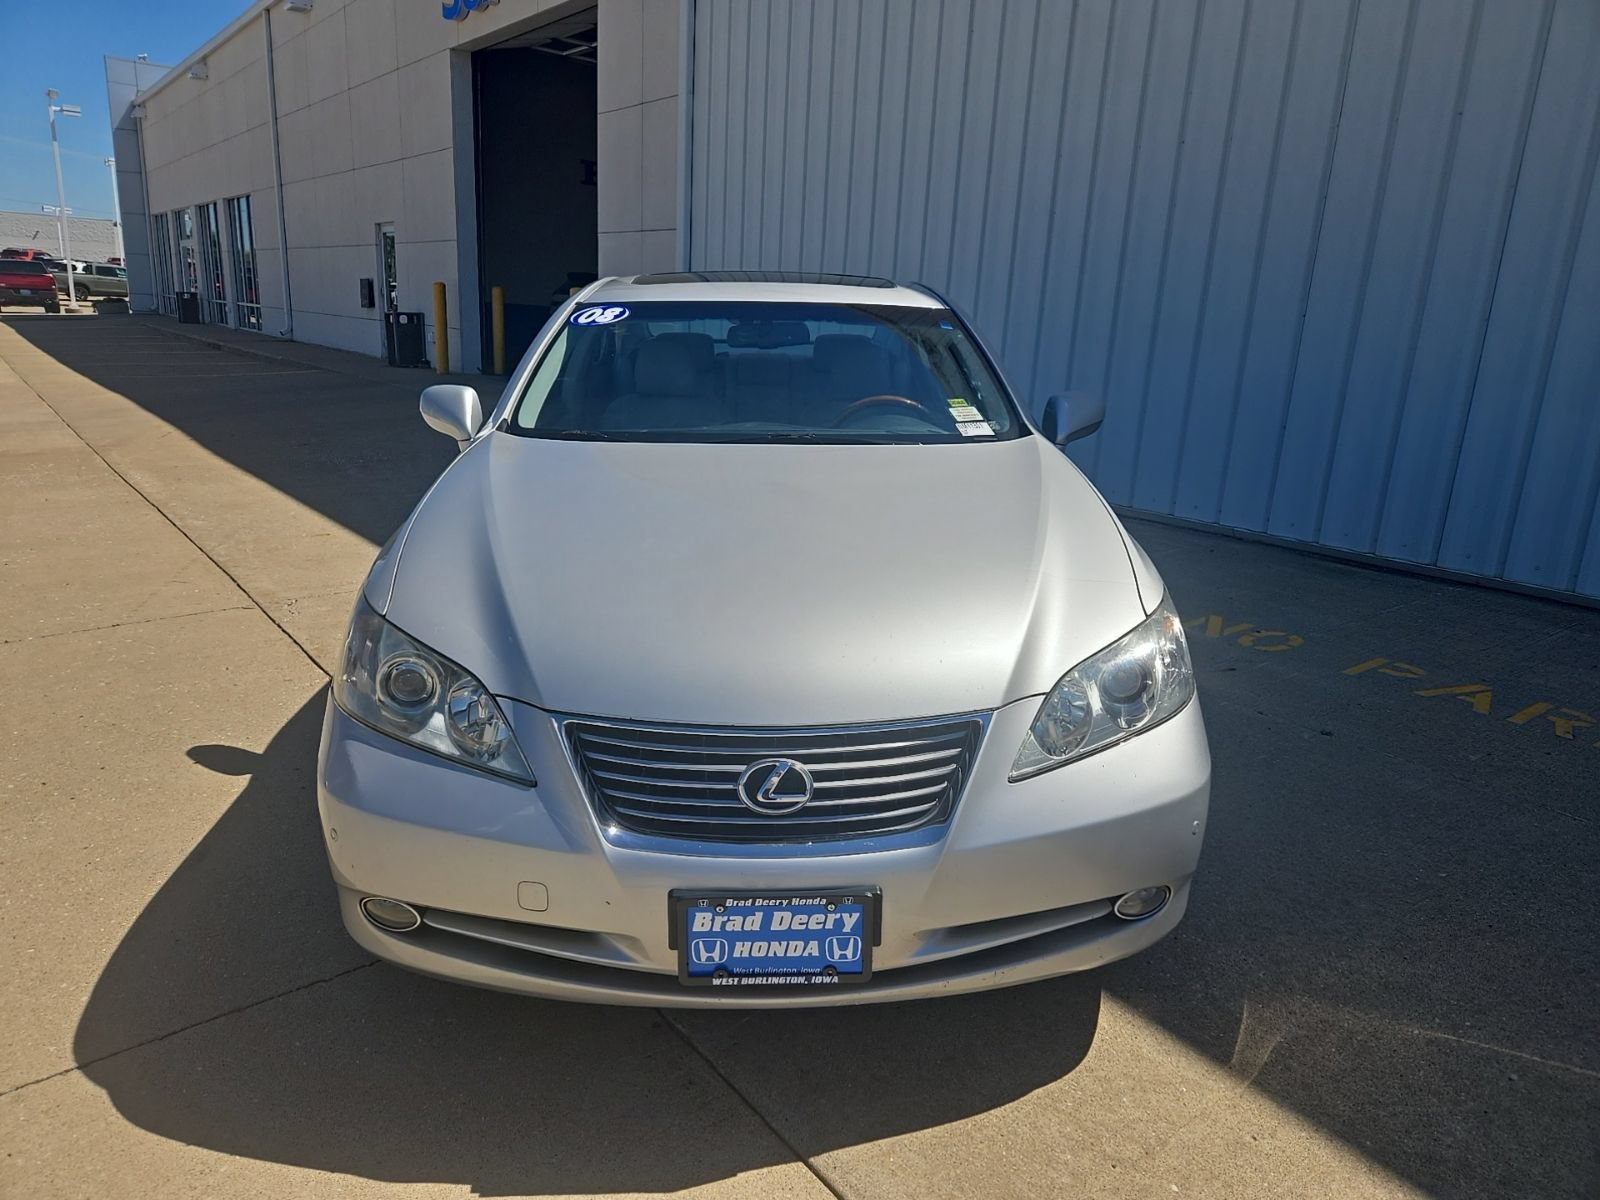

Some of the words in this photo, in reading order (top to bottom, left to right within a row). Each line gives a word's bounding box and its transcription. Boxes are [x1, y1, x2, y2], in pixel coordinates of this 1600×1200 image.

[577, 307, 624, 324] 08
[1342, 657, 1600, 750] PAR
[726, 898, 752, 907] Brad
[755, 898, 789, 907] Deery
[792, 897, 827, 906] Honda
[692, 912, 763, 932] Brad
[770, 911, 860, 933] Deery
[733, 940, 820, 958] HONDA
[712, 977, 739, 986] WEST
[811, 975, 839, 984] IOWA
